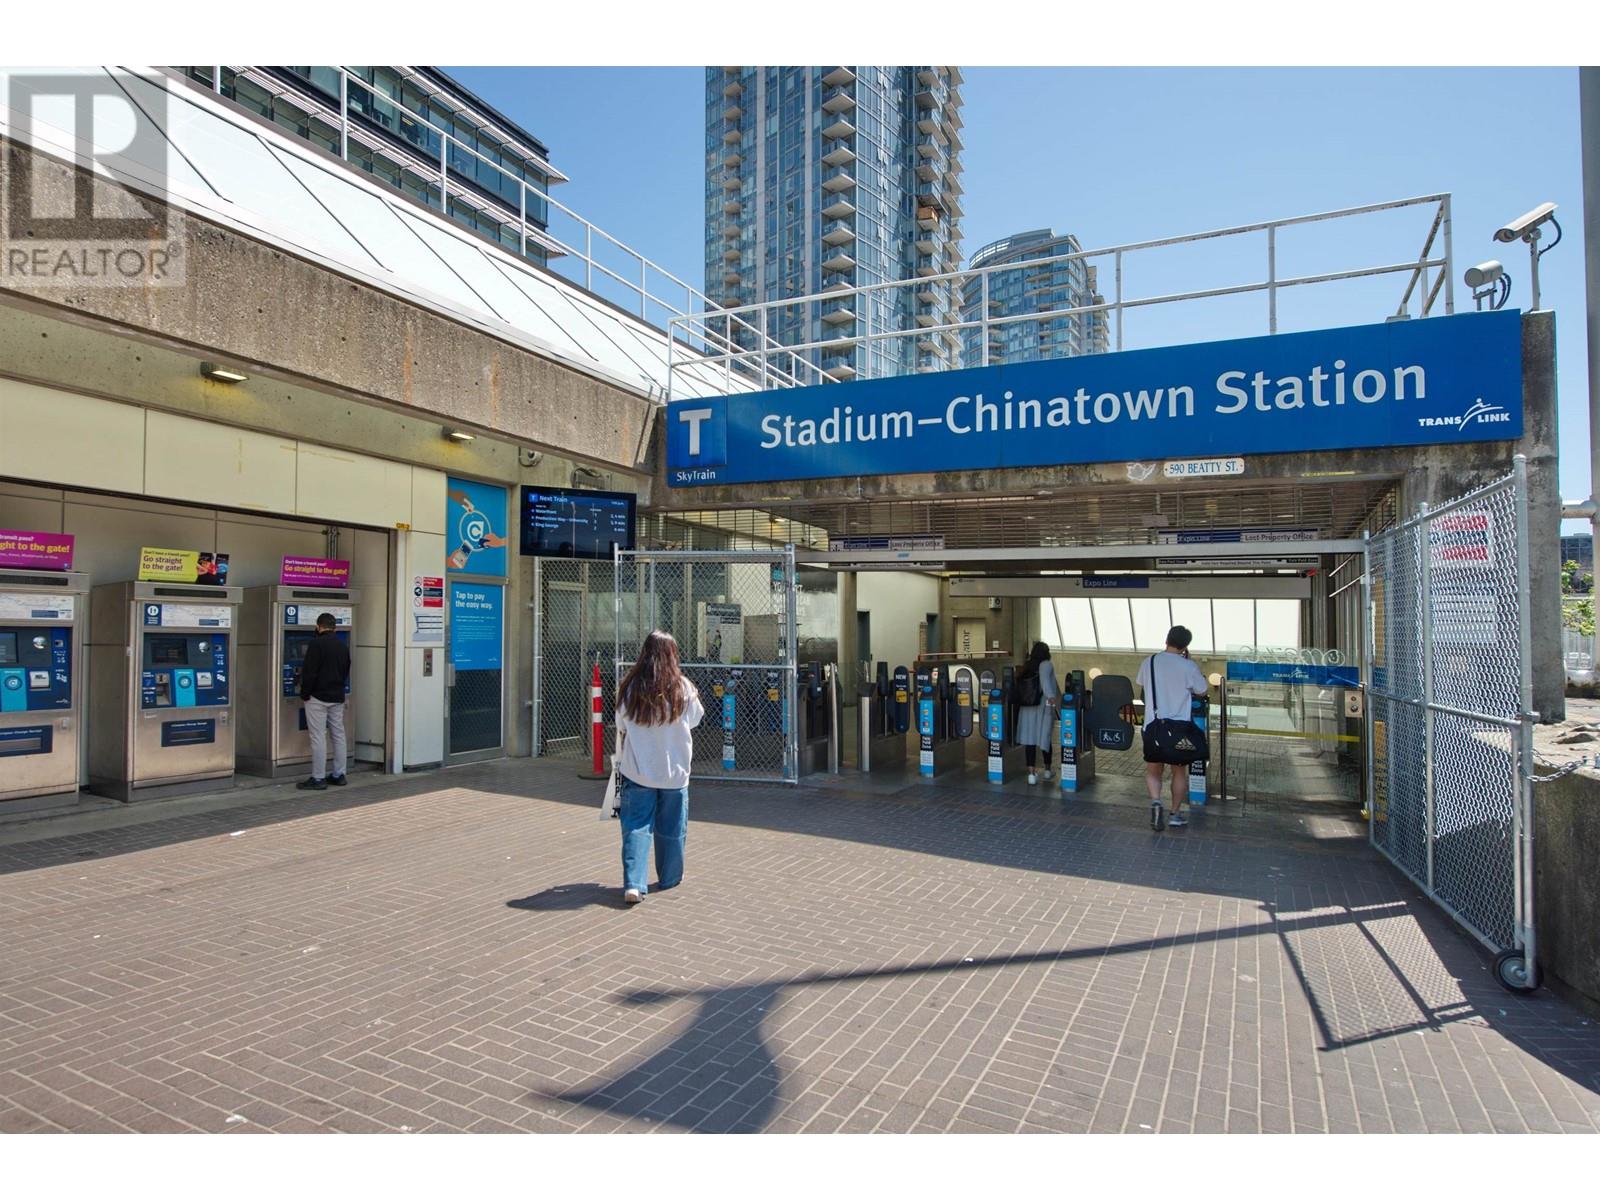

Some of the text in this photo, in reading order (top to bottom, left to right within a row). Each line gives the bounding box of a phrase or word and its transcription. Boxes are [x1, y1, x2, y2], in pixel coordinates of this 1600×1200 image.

[1215, 359, 1426, 414] Station
[679, 408, 712, 456] T
[1169, 461, 1239, 474] 590 BEATTY ST.
[676, 469, 716, 482] SkyTrain
[1261, 534, 1291, 543] Property
[1292, 532, 1313, 540] Office
[18, 542, 28, 550] to
[30, 543, 45, 552] the
[46, 544, 70, 554] gate!
[155, 556, 182, 564] straight
[456, 591, 466, 600] Tap
[474, 593, 485, 601] pay
[466, 602, 480, 610] easy
